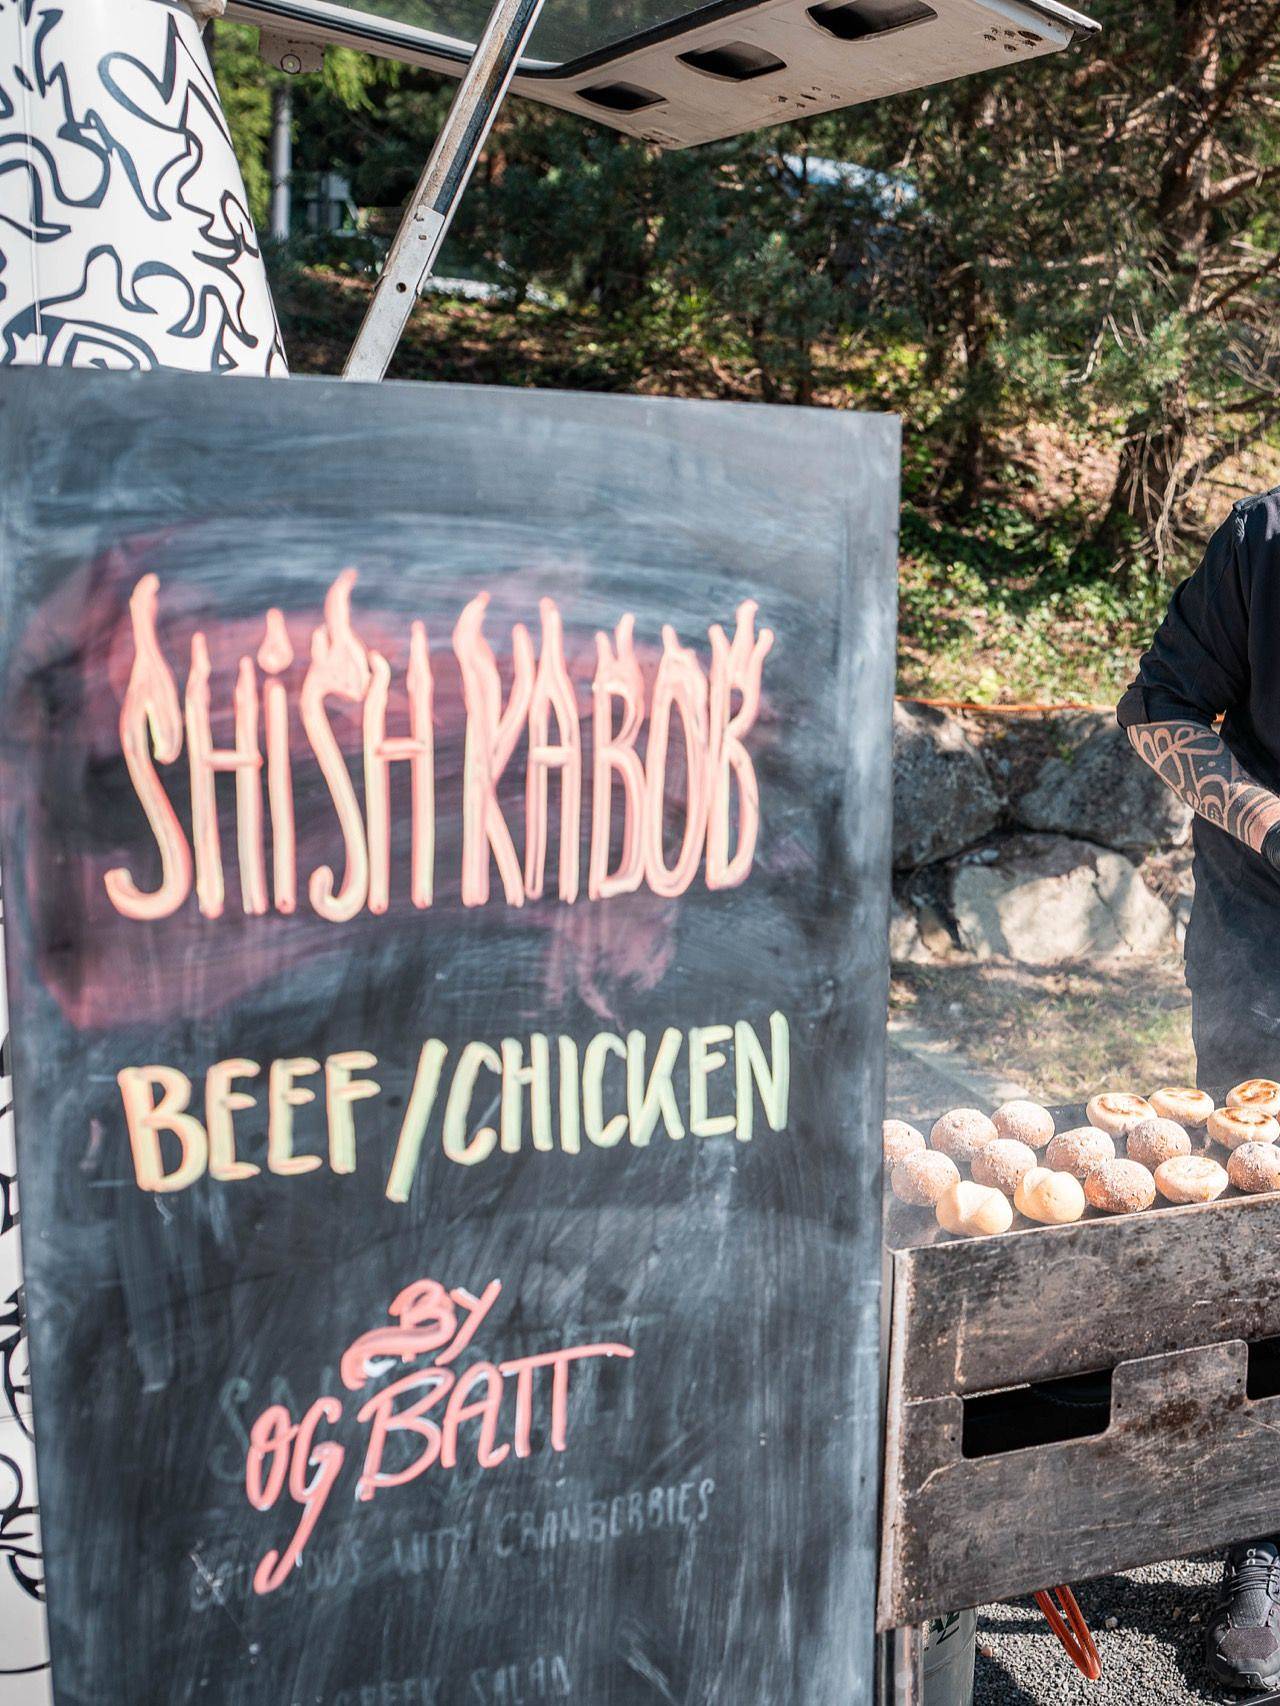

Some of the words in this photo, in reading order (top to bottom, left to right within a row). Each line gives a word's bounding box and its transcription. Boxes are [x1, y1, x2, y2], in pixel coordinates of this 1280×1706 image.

[452, 592, 775, 909] KABOB
[246, 1396, 346, 1595] OG
[354, 1343, 635, 1502] BATT
